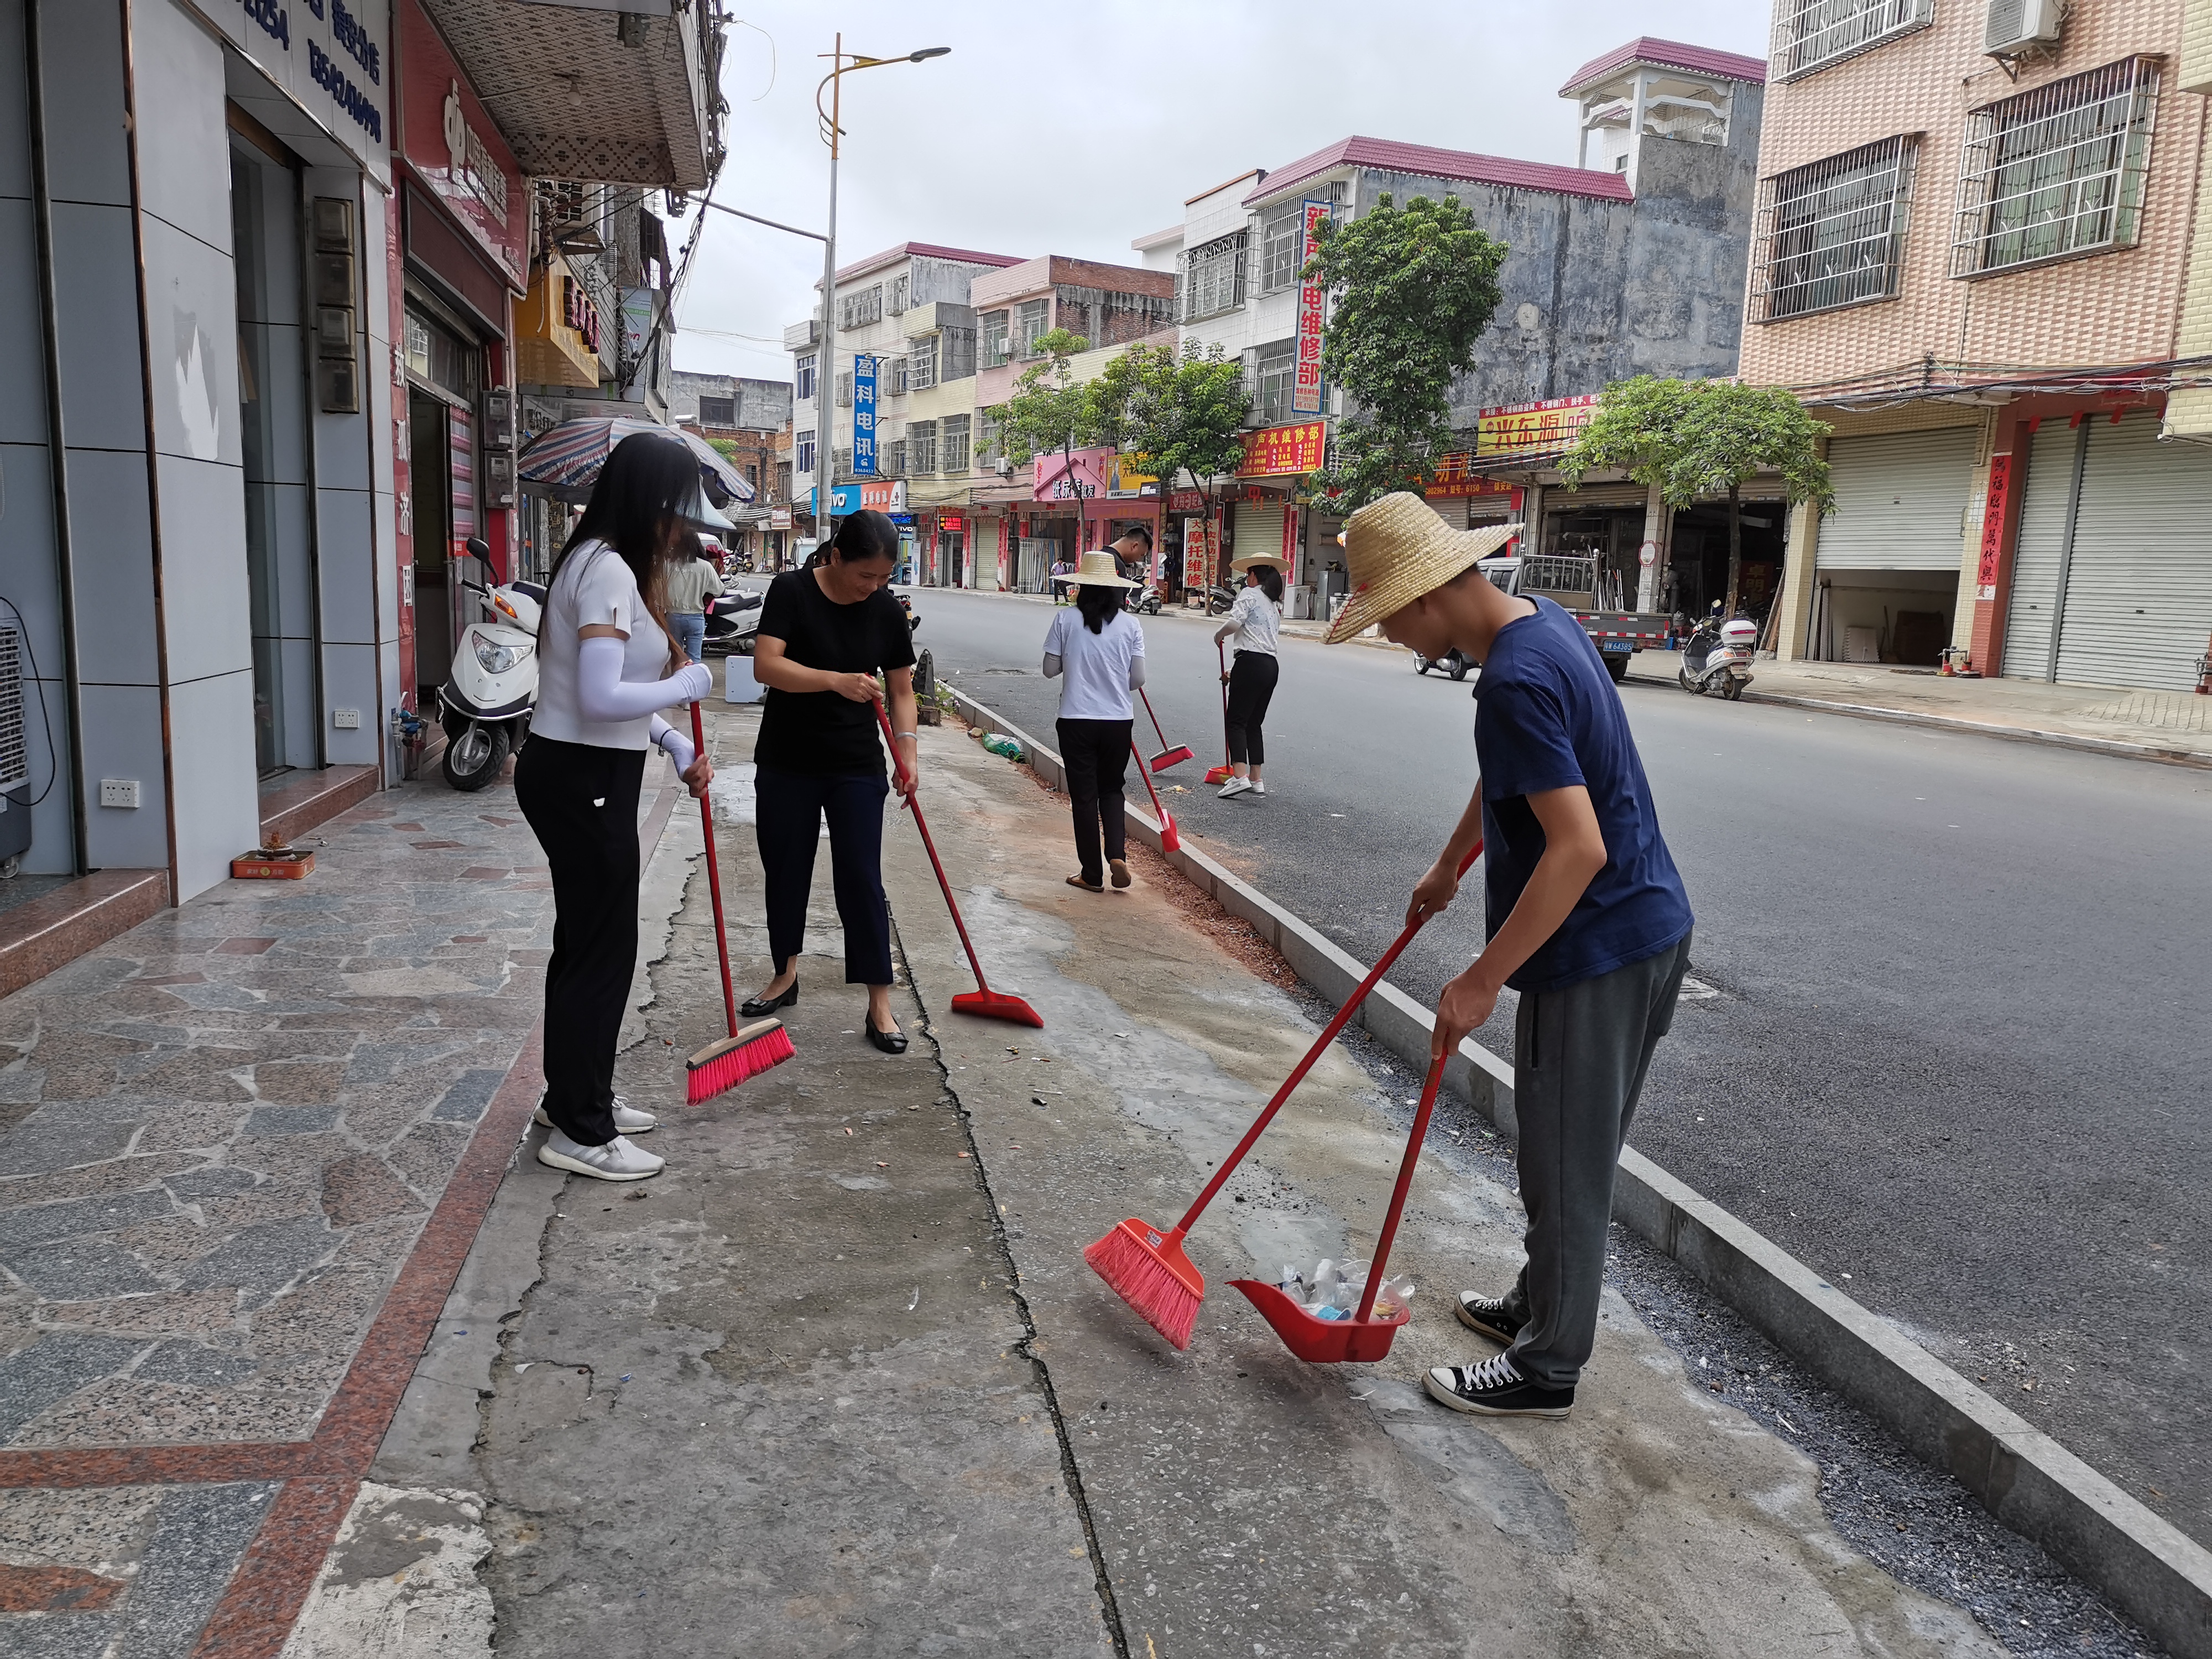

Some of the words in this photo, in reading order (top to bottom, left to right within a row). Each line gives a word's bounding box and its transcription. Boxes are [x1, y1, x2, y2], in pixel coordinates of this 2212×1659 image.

[856, 358, 874, 456] 盈科电讯
[1187, 530, 1204, 587] 摩托维修
